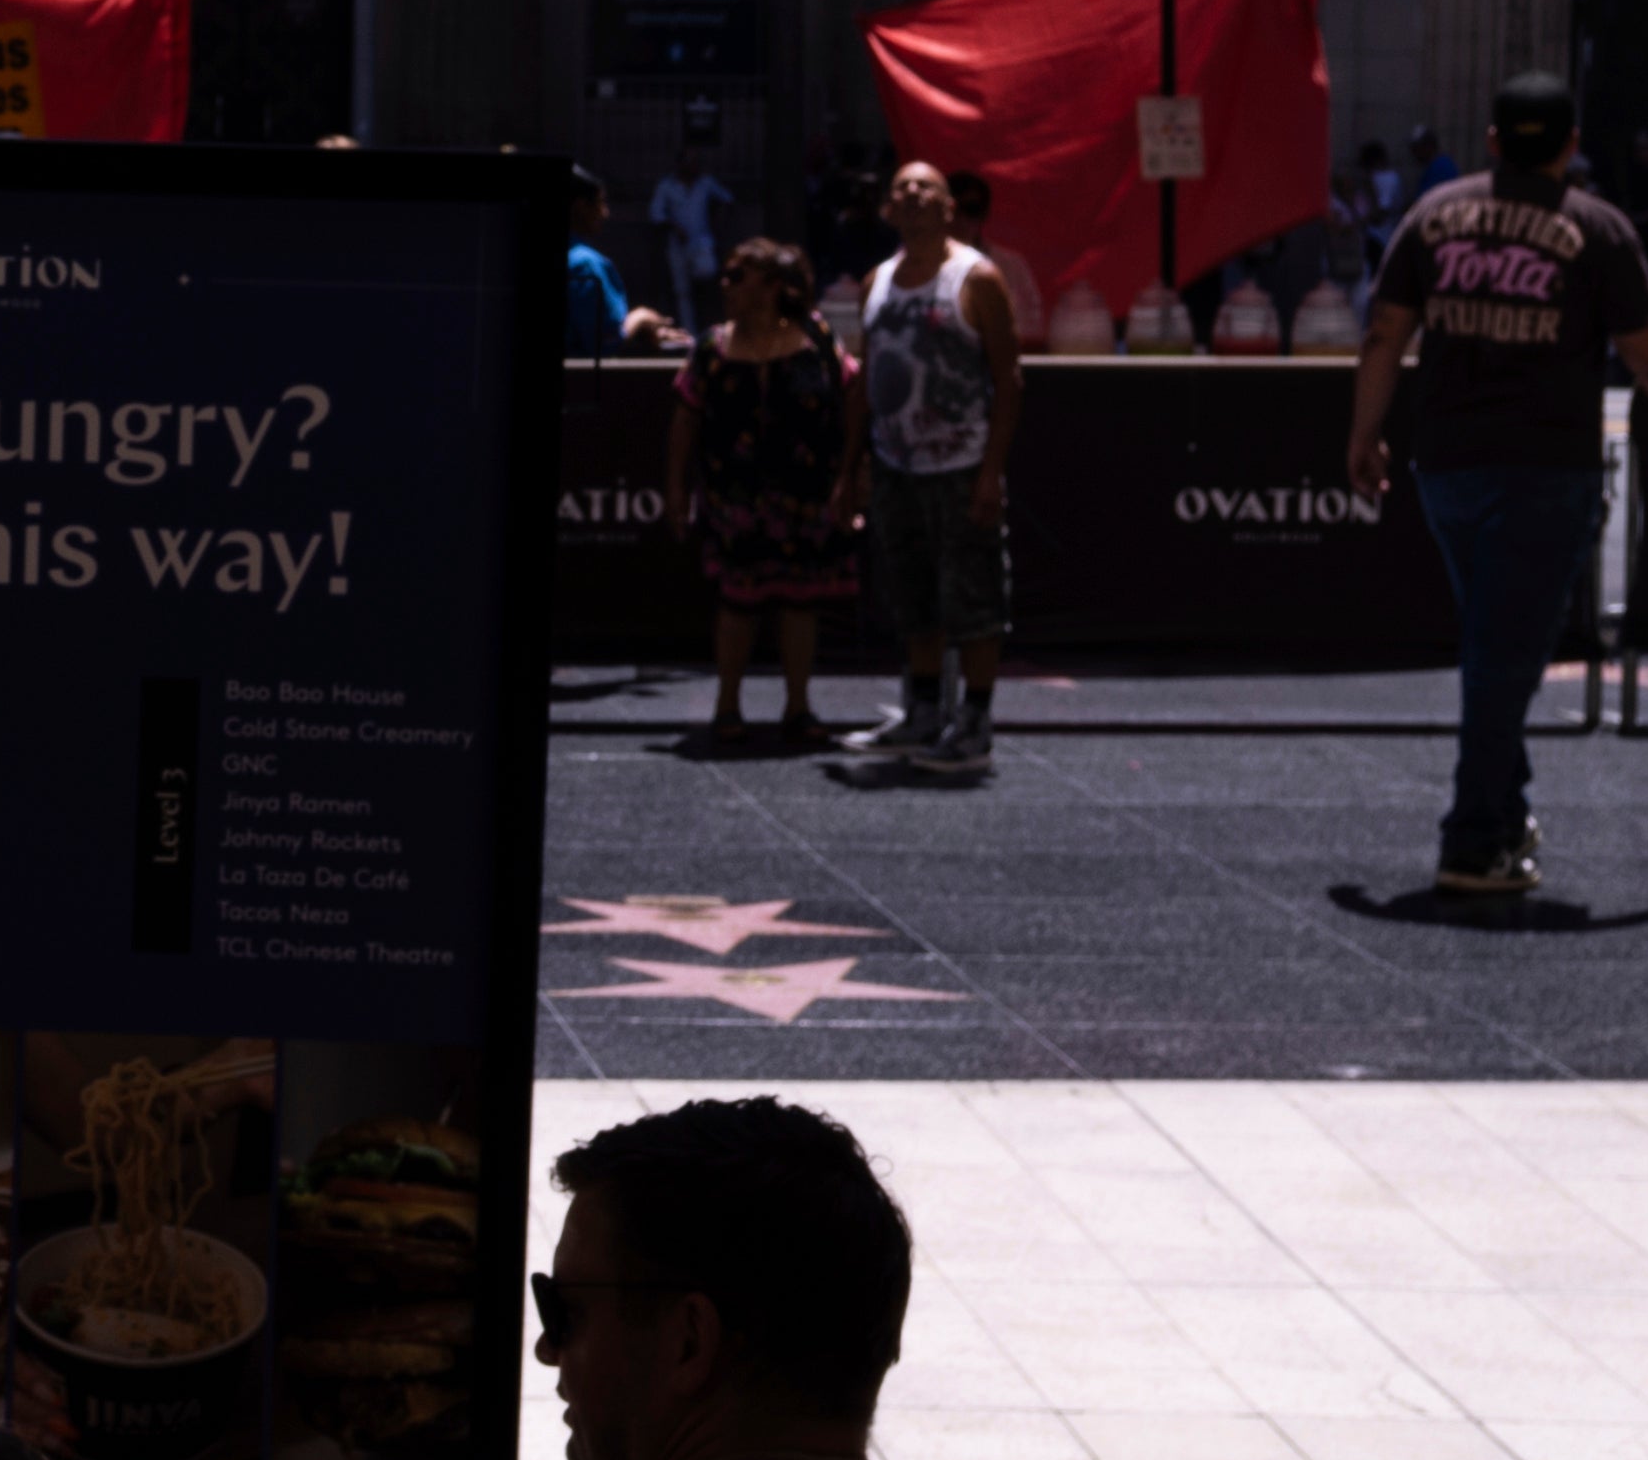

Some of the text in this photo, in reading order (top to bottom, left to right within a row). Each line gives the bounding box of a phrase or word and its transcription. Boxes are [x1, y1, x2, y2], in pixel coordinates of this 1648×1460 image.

[129, 510, 352, 614] way!
[225, 680, 406, 707] Bao Bao House
[223, 716, 475, 750] Cold Stone Creamery
[221, 753, 279, 776] GNC
[152, 766, 188, 866] Level 3
[221, 792, 372, 816] Jinya Ramen
[220, 828, 403, 856] Johnny Rockets
[218, 863, 410, 891] La Taza De Café
[217, 900, 350, 925] Tacos Neza
[216, 936, 455, 966] TCL Chinese Theatre
